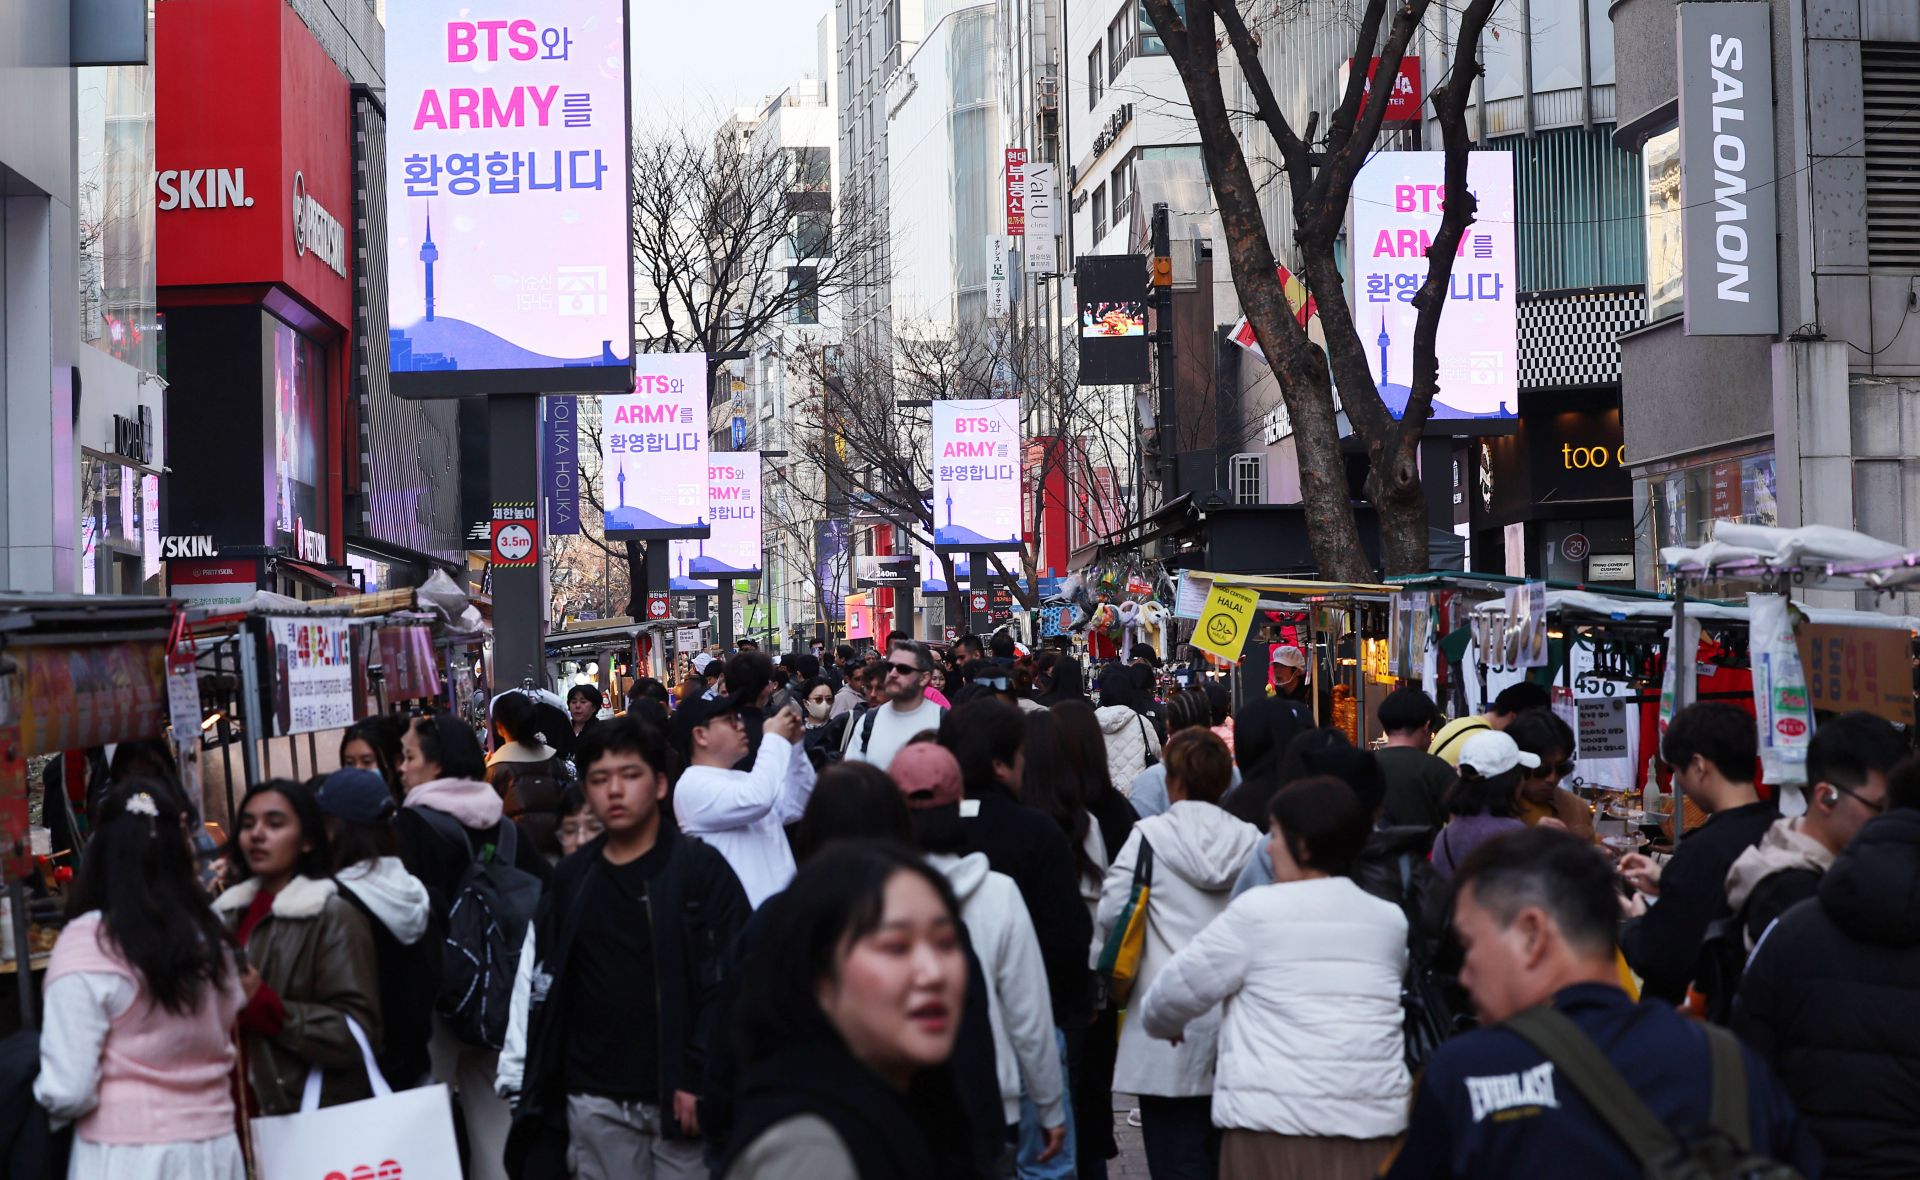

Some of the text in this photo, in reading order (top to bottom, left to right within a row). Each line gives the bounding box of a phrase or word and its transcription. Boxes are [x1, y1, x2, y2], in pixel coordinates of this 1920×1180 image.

[447, 19, 573, 63] BTS와
[413, 85, 593, 131] ARMY를
[1007, 151, 1027, 162] 현대
[403, 149, 608, 197] 환영합니다
[1710, 34, 1750, 303] SALOMON
[1030, 169, 1049, 219] Val:U
[1366, 273, 1504, 303] 환영니다
[614, 404, 694, 424] ARMY를
[955, 417, 1001, 433] BTS와
[610, 432, 700, 453] 환영합니다
[943, 441, 1009, 458] ARMY를
[1562, 442, 1609, 469] too
[939, 464, 1014, 482] 환영합니다
[555, 462, 572, 525] HOLIKA
[492, 507, 535, 520] 제한높이
[501, 537, 530, 547] 3.5m
[1217, 596, 1244, 614] HALAL
[1229, 590, 1253, 604] CERTIFIED
[1210, 619, 1233, 636] حلال
